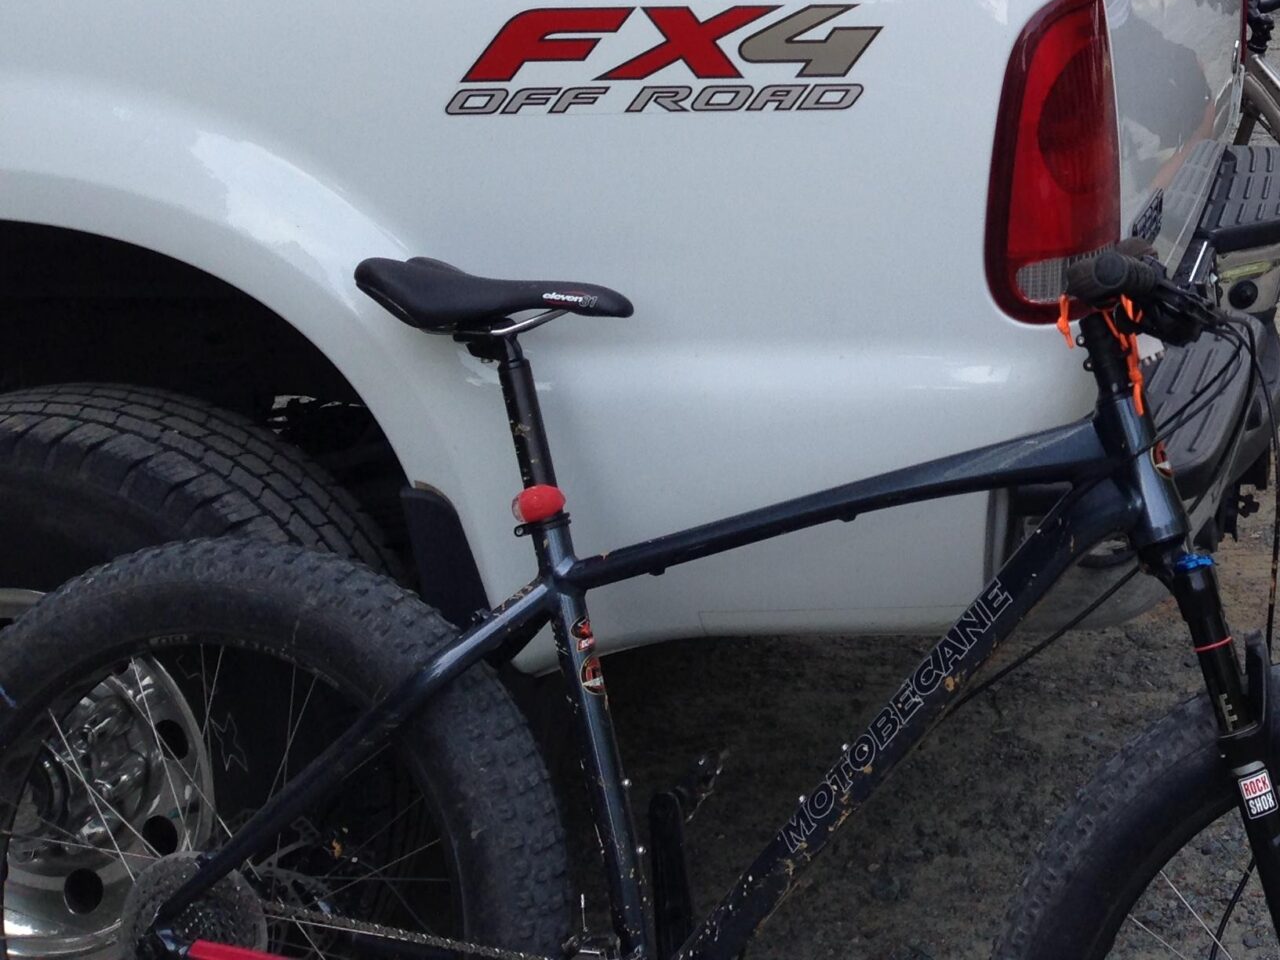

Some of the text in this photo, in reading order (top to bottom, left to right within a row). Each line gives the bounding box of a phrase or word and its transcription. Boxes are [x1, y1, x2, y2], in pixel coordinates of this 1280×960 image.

[460, 4, 885, 82] FX4
[445, 83, 864, 115] OFF ROAD
[778, 577, 1014, 854] MOTOBECANE
[1243, 775, 1269, 797] ROCK
[1249, 792, 1275, 814] SHOX
